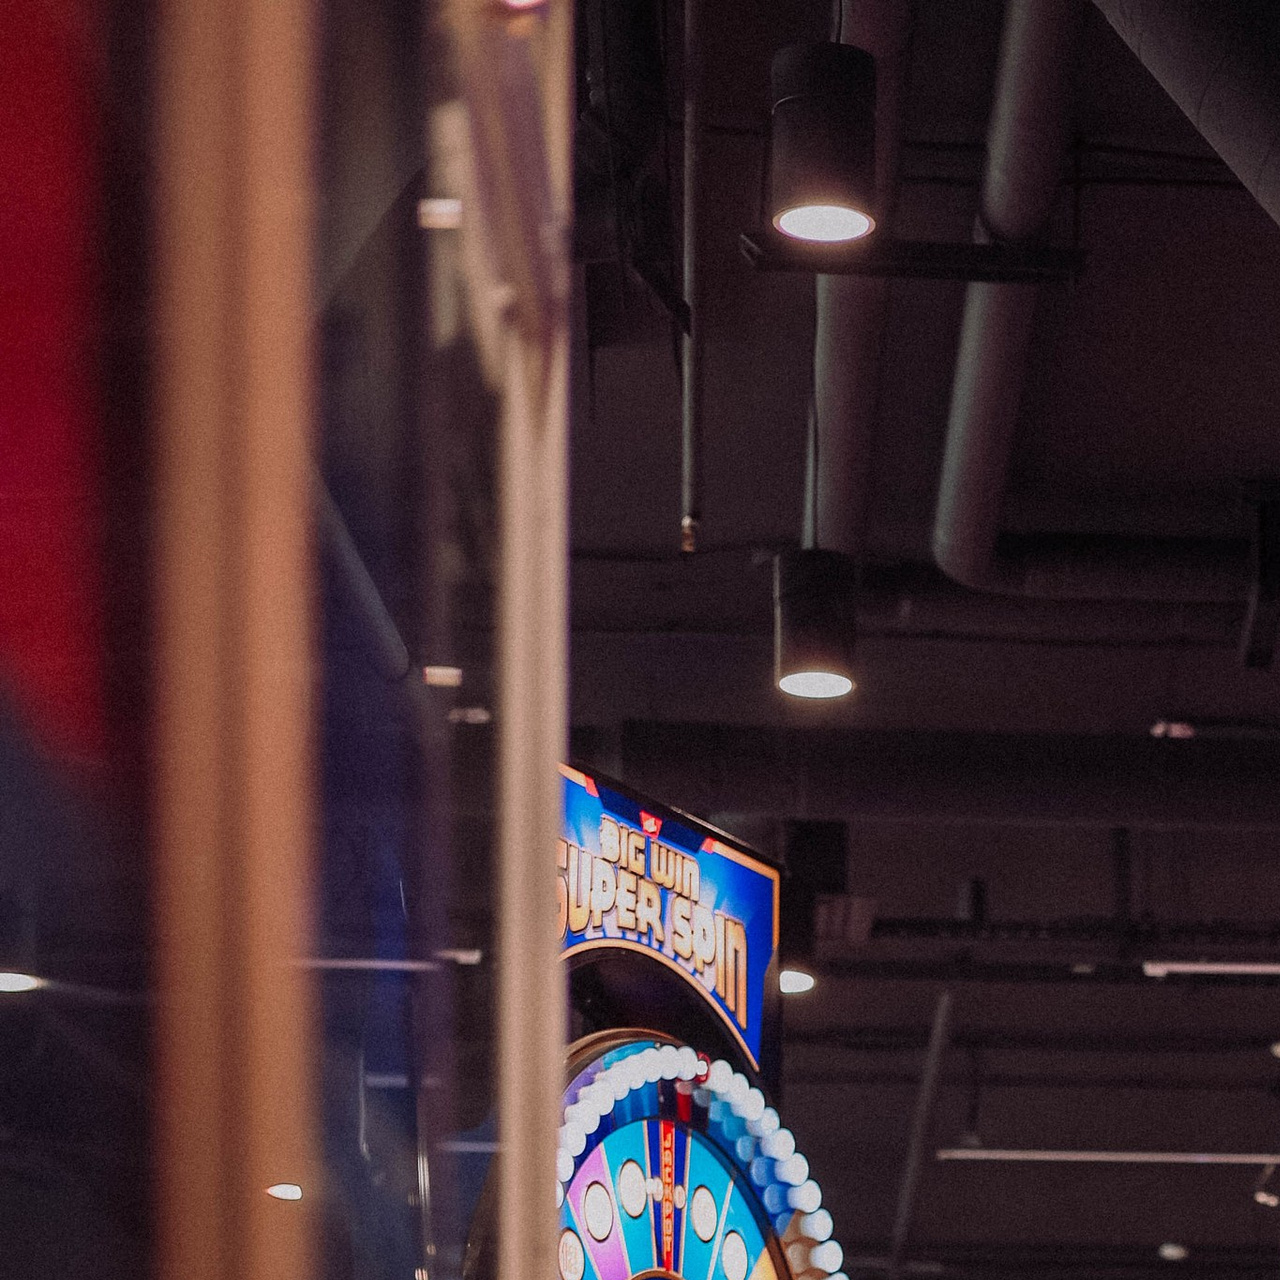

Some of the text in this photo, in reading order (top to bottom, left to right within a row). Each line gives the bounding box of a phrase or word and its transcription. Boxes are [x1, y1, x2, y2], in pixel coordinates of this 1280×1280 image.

[600, 814, 699, 901] BIG WIN
[670, 894, 747, 1030] SPIN
